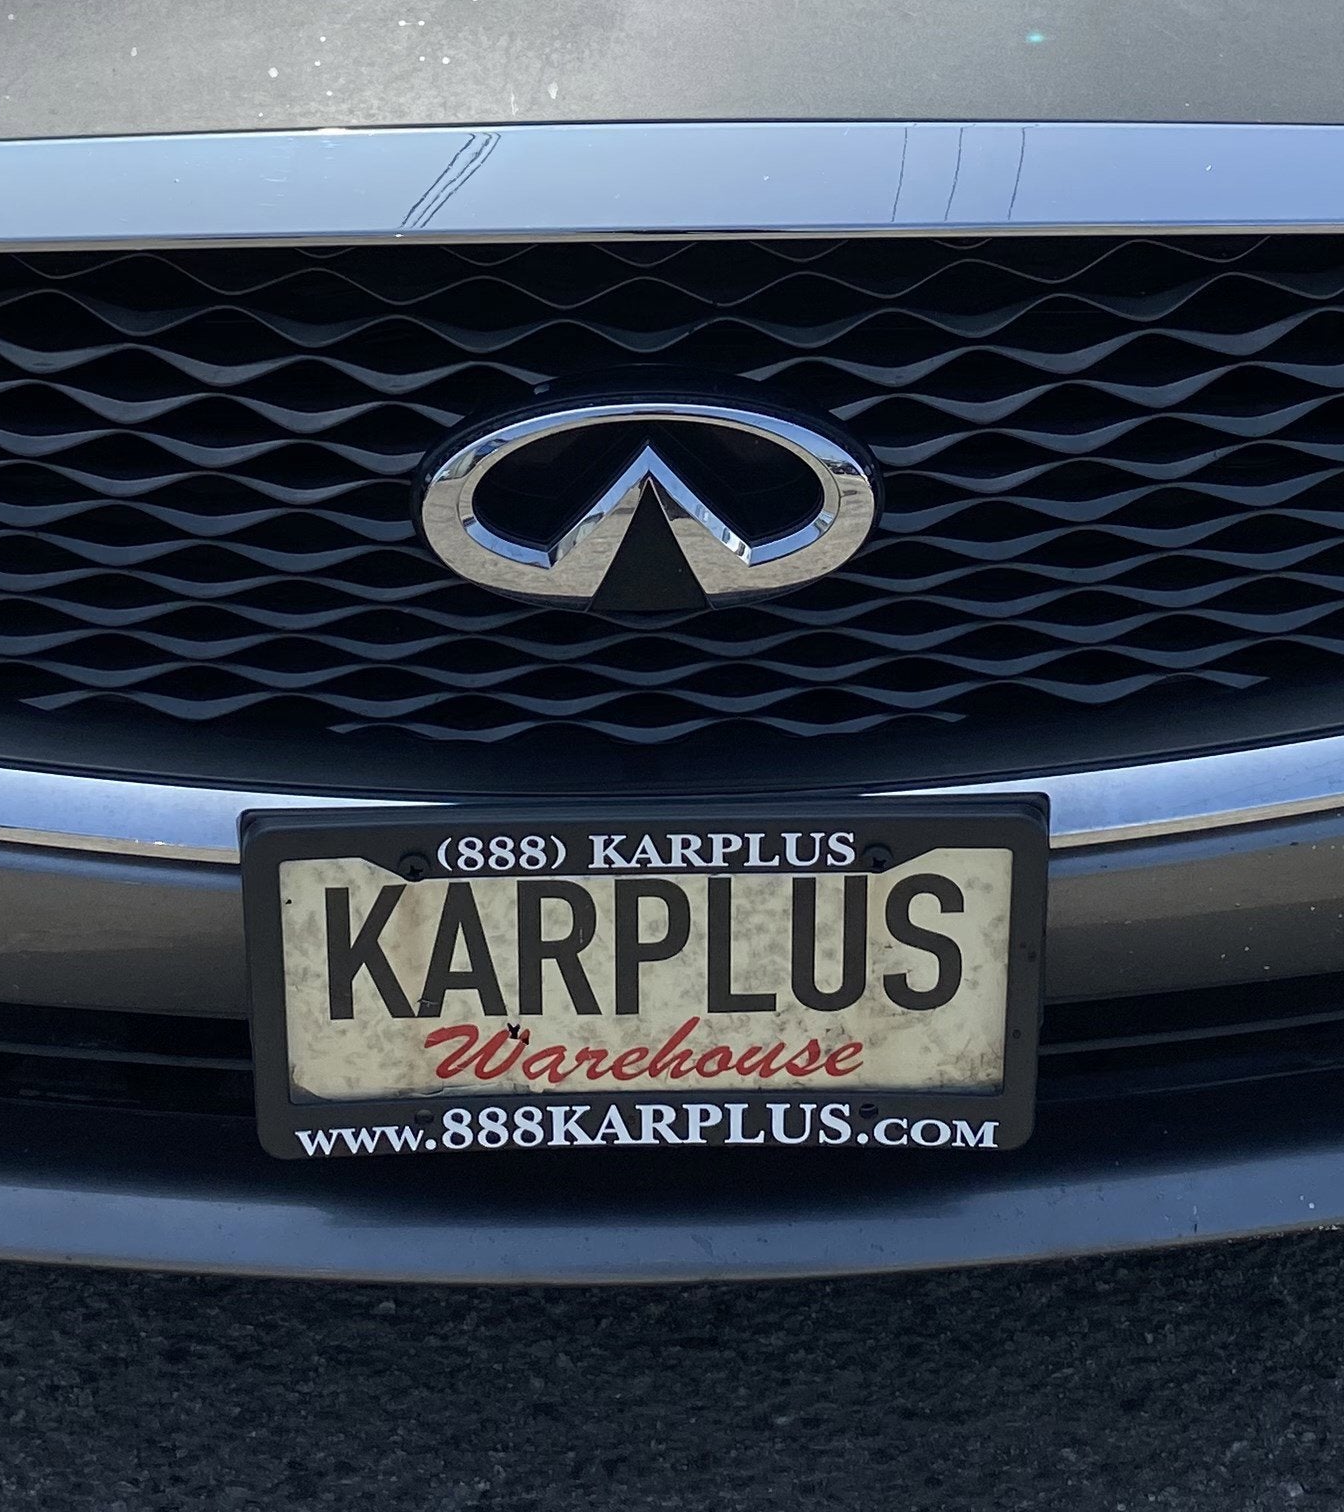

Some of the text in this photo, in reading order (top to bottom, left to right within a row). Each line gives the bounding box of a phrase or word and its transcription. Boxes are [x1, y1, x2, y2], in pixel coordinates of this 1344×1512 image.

[437, 832, 855, 871] (888) KARPLUS
[324, 873, 964, 1020] KARPLUS
[424, 1016, 863, 1084] Warehouse
